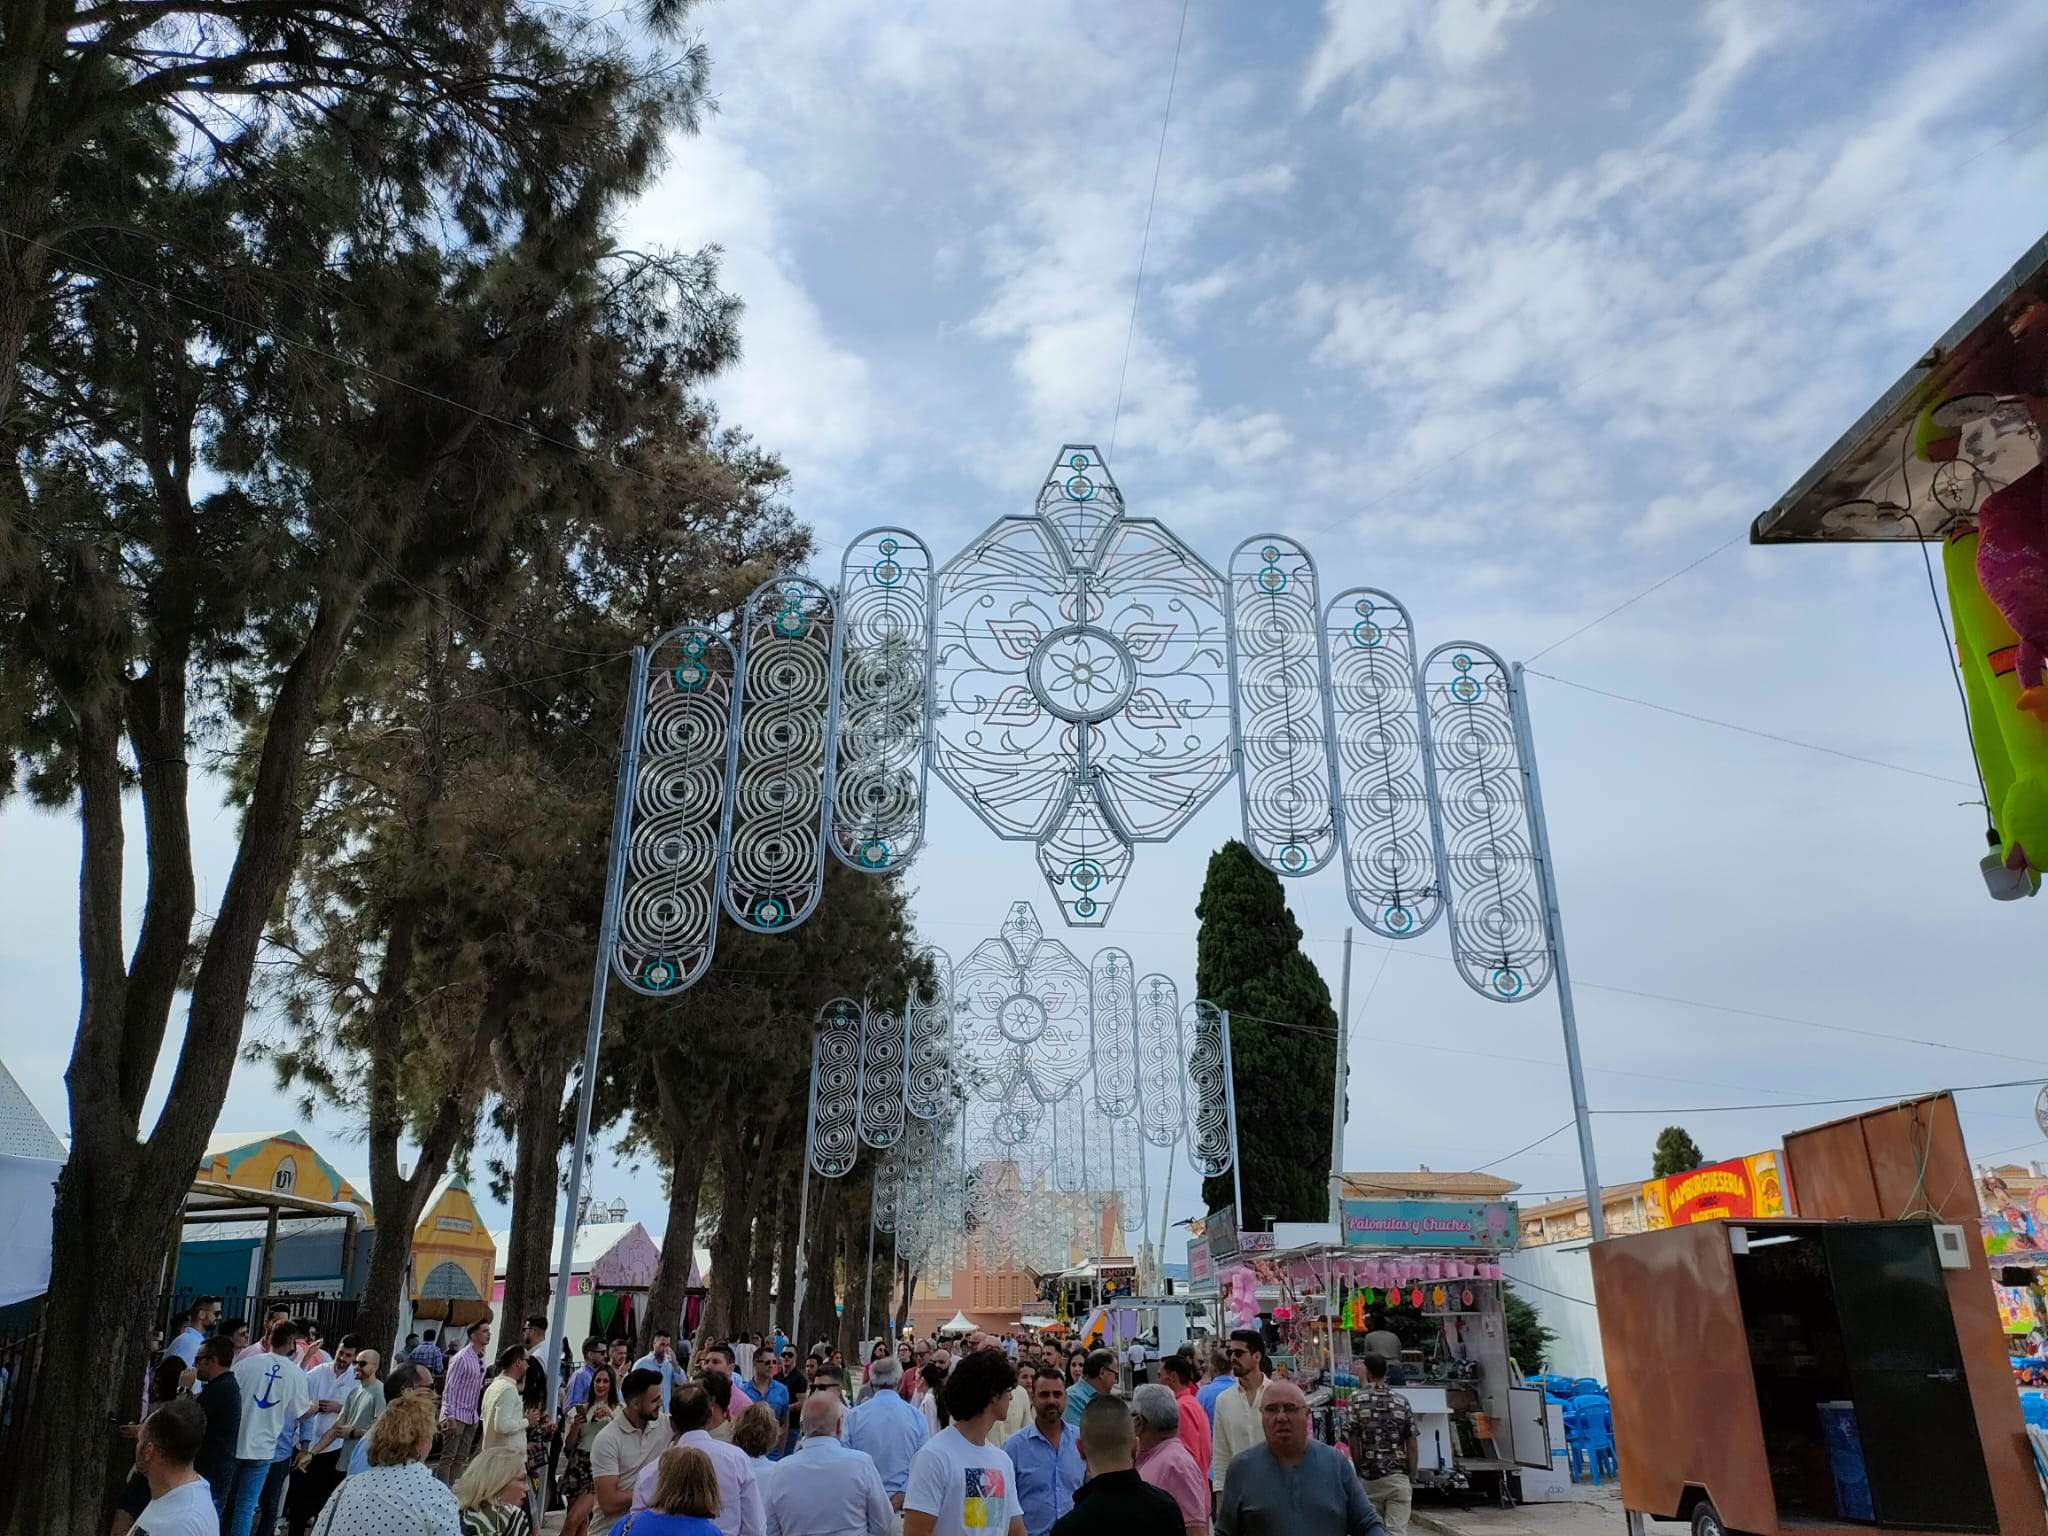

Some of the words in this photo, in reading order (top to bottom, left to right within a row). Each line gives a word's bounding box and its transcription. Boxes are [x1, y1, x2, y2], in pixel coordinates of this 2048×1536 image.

[1349, 1216, 1409, 1231] Palomitas
[1411, 1219, 1422, 1236] y
[1423, 1217, 1472, 1232] Chuches
